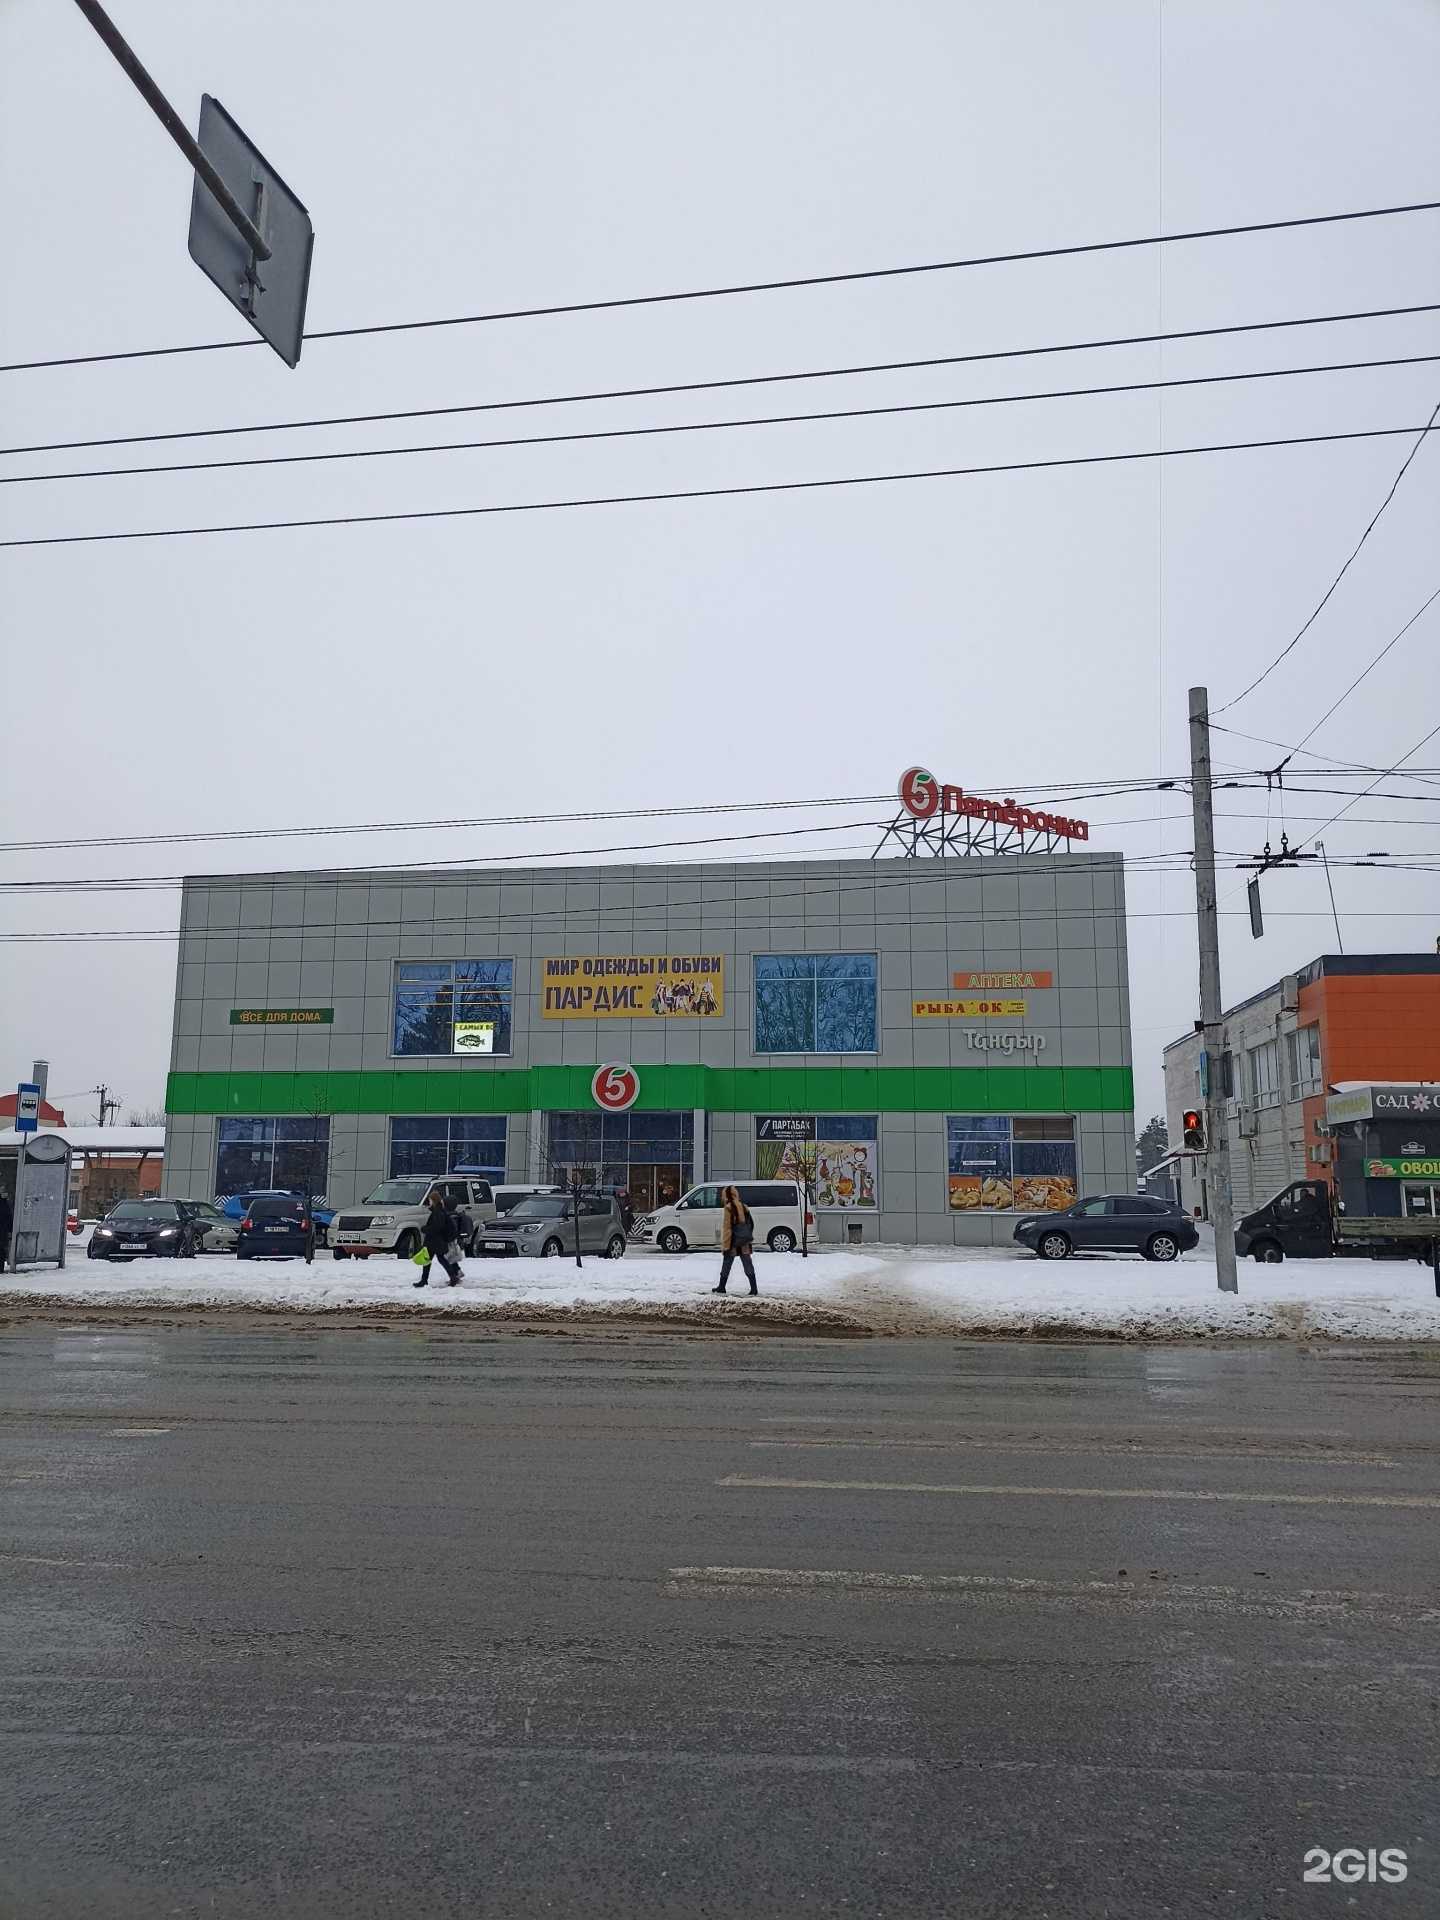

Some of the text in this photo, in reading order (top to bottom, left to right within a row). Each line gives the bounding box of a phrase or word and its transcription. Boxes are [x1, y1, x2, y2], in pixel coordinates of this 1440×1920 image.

[943, 784, 1089, 840] Пятёрочка
[547, 957, 721, 977] МИР ОДЕЖДЫ И ОБУВИ
[968, 973, 1035, 987] АПТЕКА
[545, 985, 643, 1012] ПАРДИС
[242, 1012, 320, 1022] ВСЕ ДЛЯ ДОМА
[963, 1029, 1046, 1056] Тандыр
[605, 1067, 629, 1101] 5
[1376, 1095, 1409, 1109] САД
